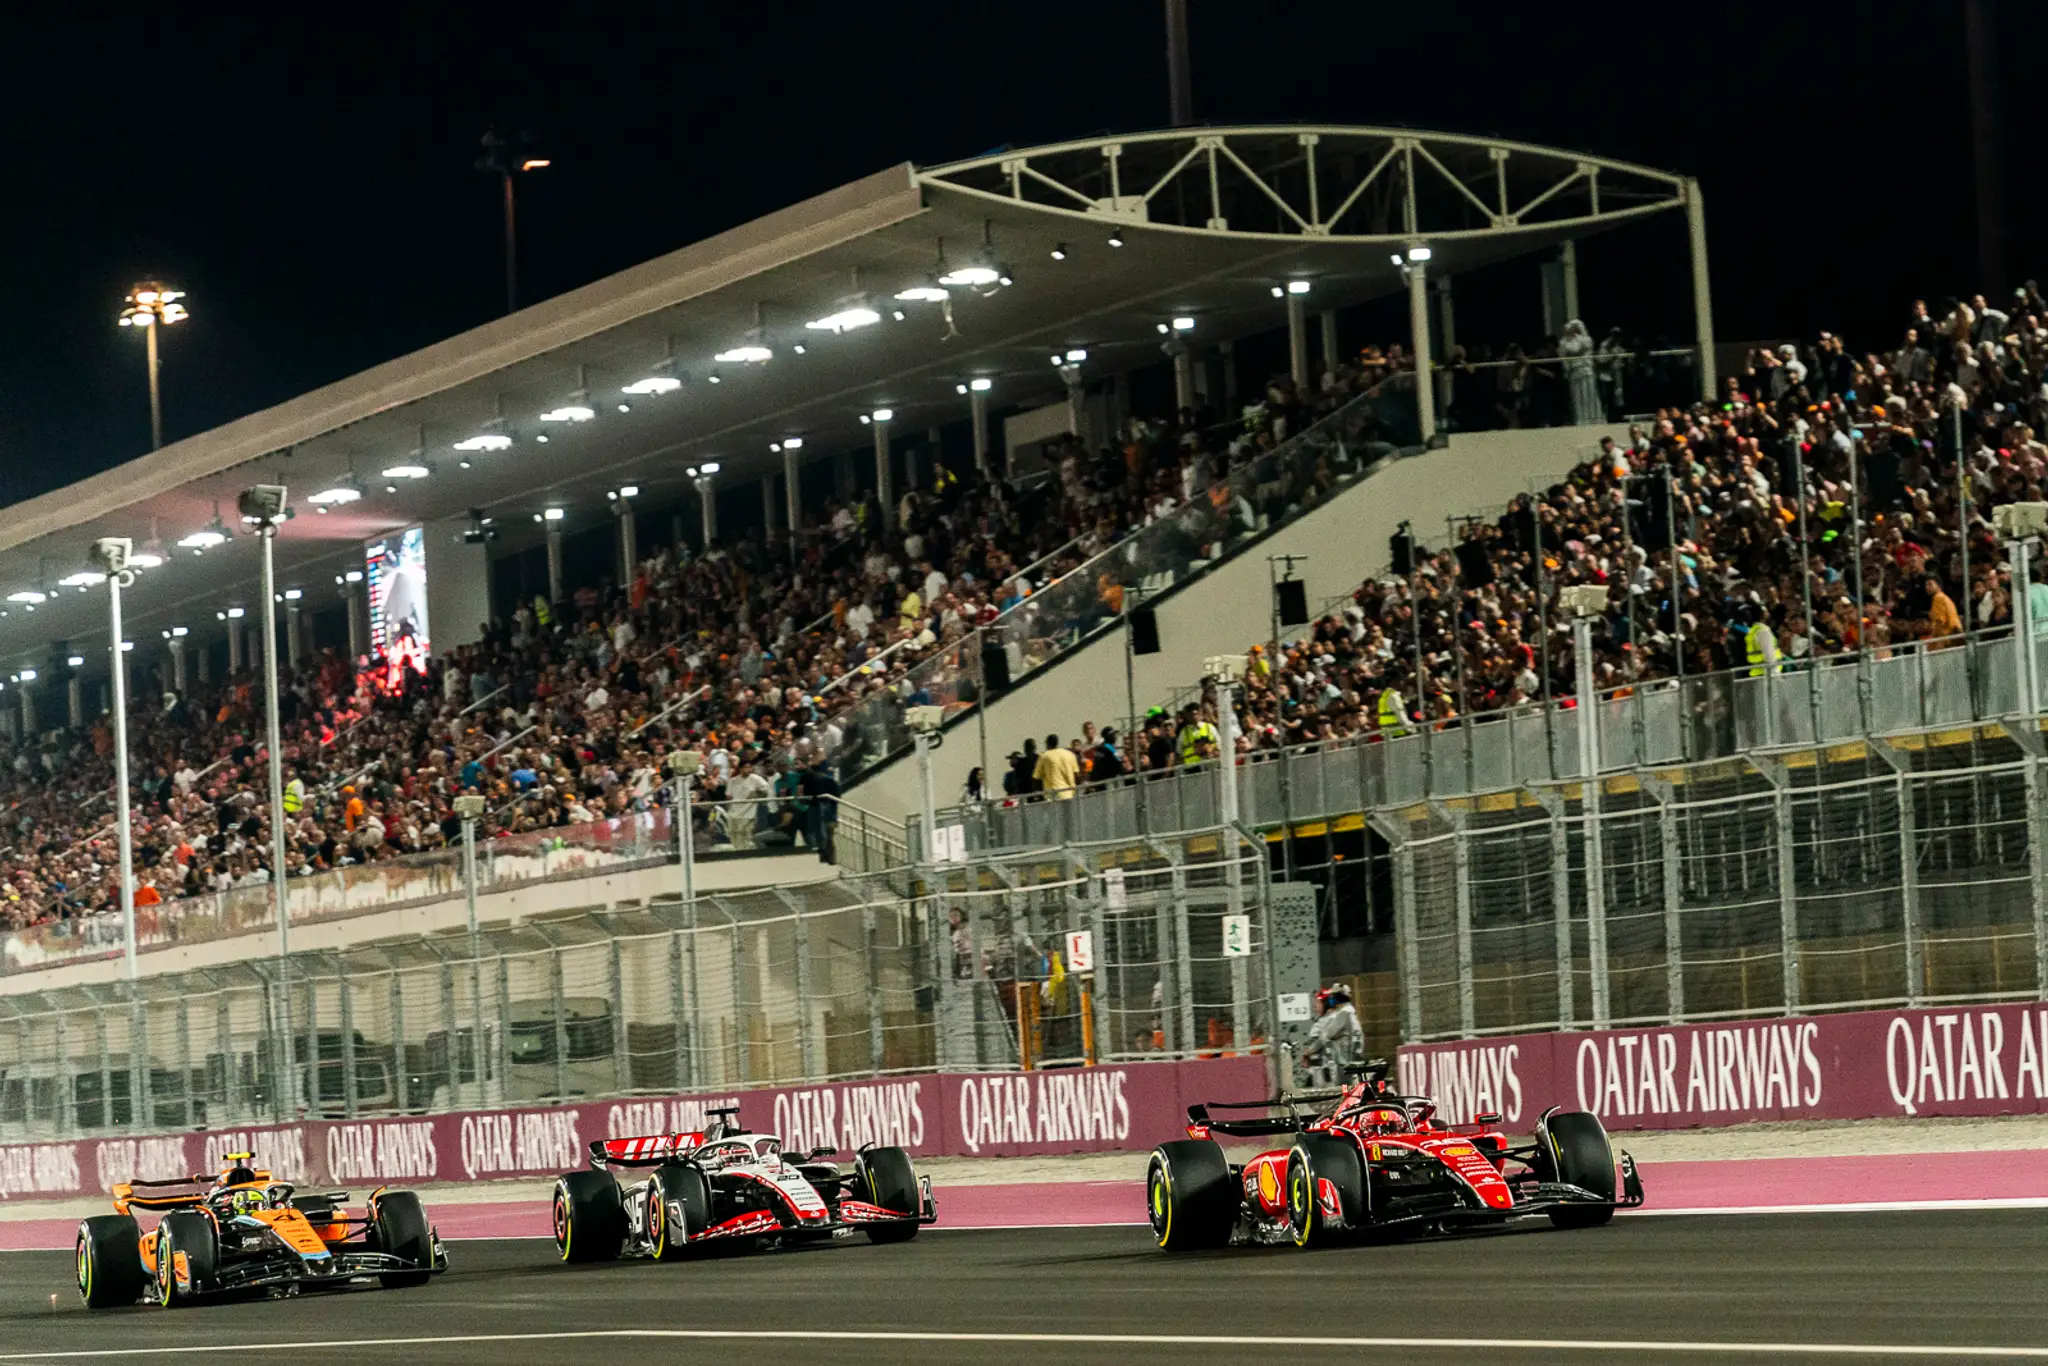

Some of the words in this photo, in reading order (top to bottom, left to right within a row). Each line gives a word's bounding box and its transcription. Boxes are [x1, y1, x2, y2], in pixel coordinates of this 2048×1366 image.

[1398, 1052, 1428, 1097] TAR
[1430, 1044, 1523, 1125] AIRWAYS
[1576, 1033, 1681, 1117] QATAR
[1686, 1022, 1822, 1113] AIRWAYS
[1886, 1012, 2010, 1115] QATAR
[461, 1115, 515, 1180] QATAR
[516, 1110, 582, 1170] AIRWAYS
[774, 1088, 839, 1153] QATAR
[841, 1081, 924, 1151] AIRWAYS
[960, 1076, 1034, 1153] QATAR
[1036, 1070, 1130, 1143] AIRWAYS
[327, 1123, 375, 1185] QATAR
[376, 1121, 437, 1178] AIRWAYS
